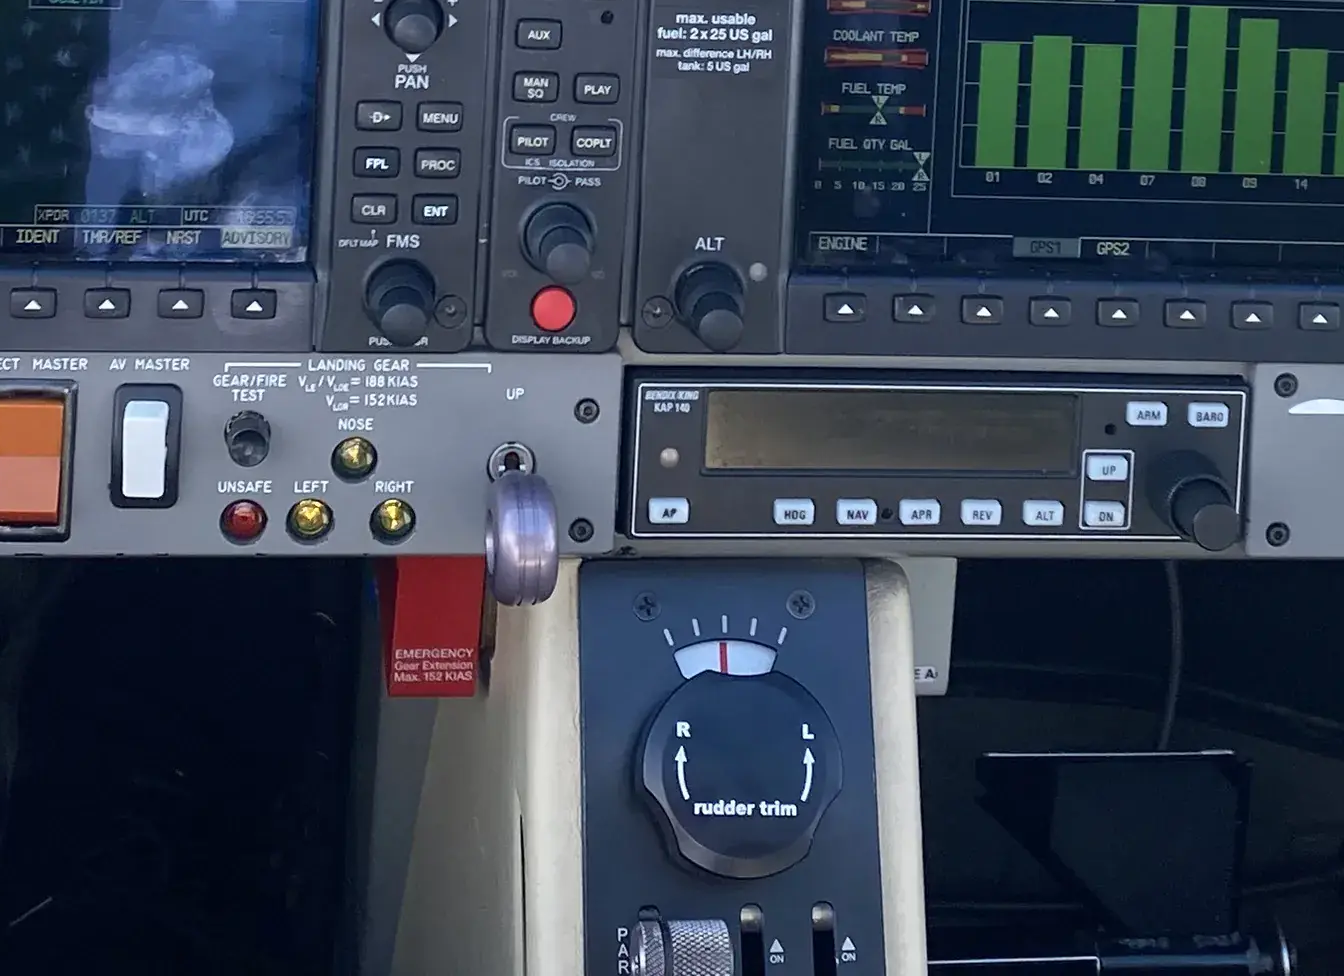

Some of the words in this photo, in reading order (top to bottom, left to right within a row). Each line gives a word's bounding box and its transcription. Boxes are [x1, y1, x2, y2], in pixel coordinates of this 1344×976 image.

[675, 14, 709, 25] max.
[711, 12, 756, 26] usable
[657, 26, 687, 40] fuel:
[729, 28, 749, 41] US
[751, 28, 773, 44] gal
[422, 112, 459, 124] MENU
[365, 157, 389, 170] FPL
[423, 205, 449, 217] ENT
[386, 234, 420, 249] FMS
[818, 236, 868, 252] ENGINE
[1096, 241, 1130, 256] GPS2
[511, 334, 551, 345] DISPLAY
[552, 335, 591, 345] BACKUP
[32, 357, 89, 371] MASTER
[308, 358, 366, 372] LANDING
[373, 358, 410, 372] GEAR
[212, 373, 288, 388] GEAR/FIRE
[338, 417, 374, 431] NOSE
[1196, 411, 1224, 423] BARO
[217, 480, 273, 494] UNSAFE
[375, 480, 415, 493] RIGHT
[846, 509, 869, 521] NAV
[395, 647, 474, 660] EMERGENCY
[676, 721, 691, 738] R
[802, 723, 815, 740] L
[693, 799, 756, 816] rudder
[758, 800, 797, 817] trim
